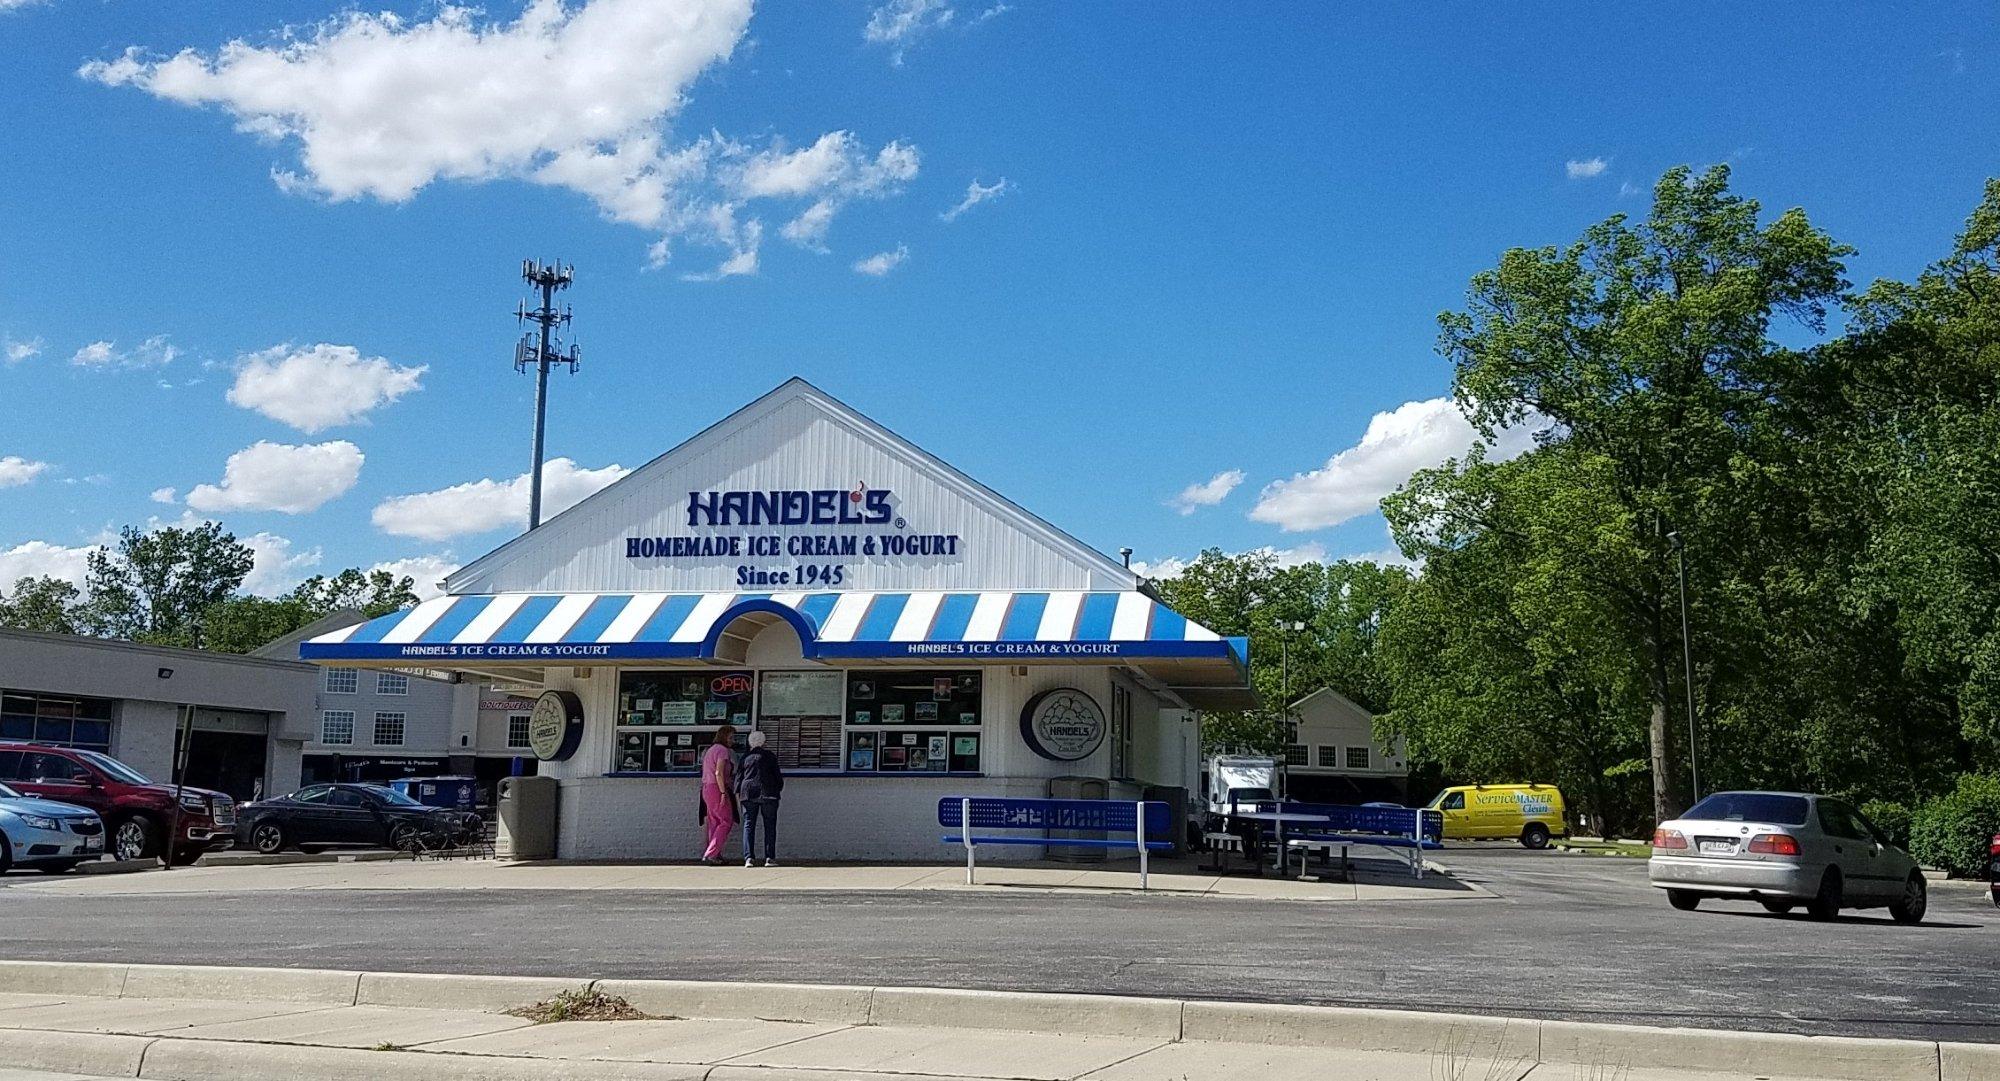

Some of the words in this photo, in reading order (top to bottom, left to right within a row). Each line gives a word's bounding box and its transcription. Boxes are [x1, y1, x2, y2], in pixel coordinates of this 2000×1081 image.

[687, 489, 892, 526] HANDEL'S
[626, 537, 740, 558] HOMEMADE
[747, 536, 781, 556] ICE
[787, 535, 857, 556] CREAM
[863, 535, 876, 556] &
[880, 534, 958, 556] YOGURT
[736, 565, 789, 585] Since
[795, 565, 844, 585] 1945
[402, 645, 457, 655] HANDEL'S
[461, 645, 484, 655] ICE
[487, 645, 537, 655] CREAM
[541, 646, 552, 655] &
[554, 645, 610, 655] YOGURT
[908, 644, 964, 653] HANDEL'S
[969, 644, 992, 653] ICE
[995, 643, 1045, 653] CREAM
[1049, 643, 1061, 653] &
[1063, 643, 1120, 653] YOGURT
[711, 677, 752, 692] OPEN
[1522, 804, 1548, 813] Clean
